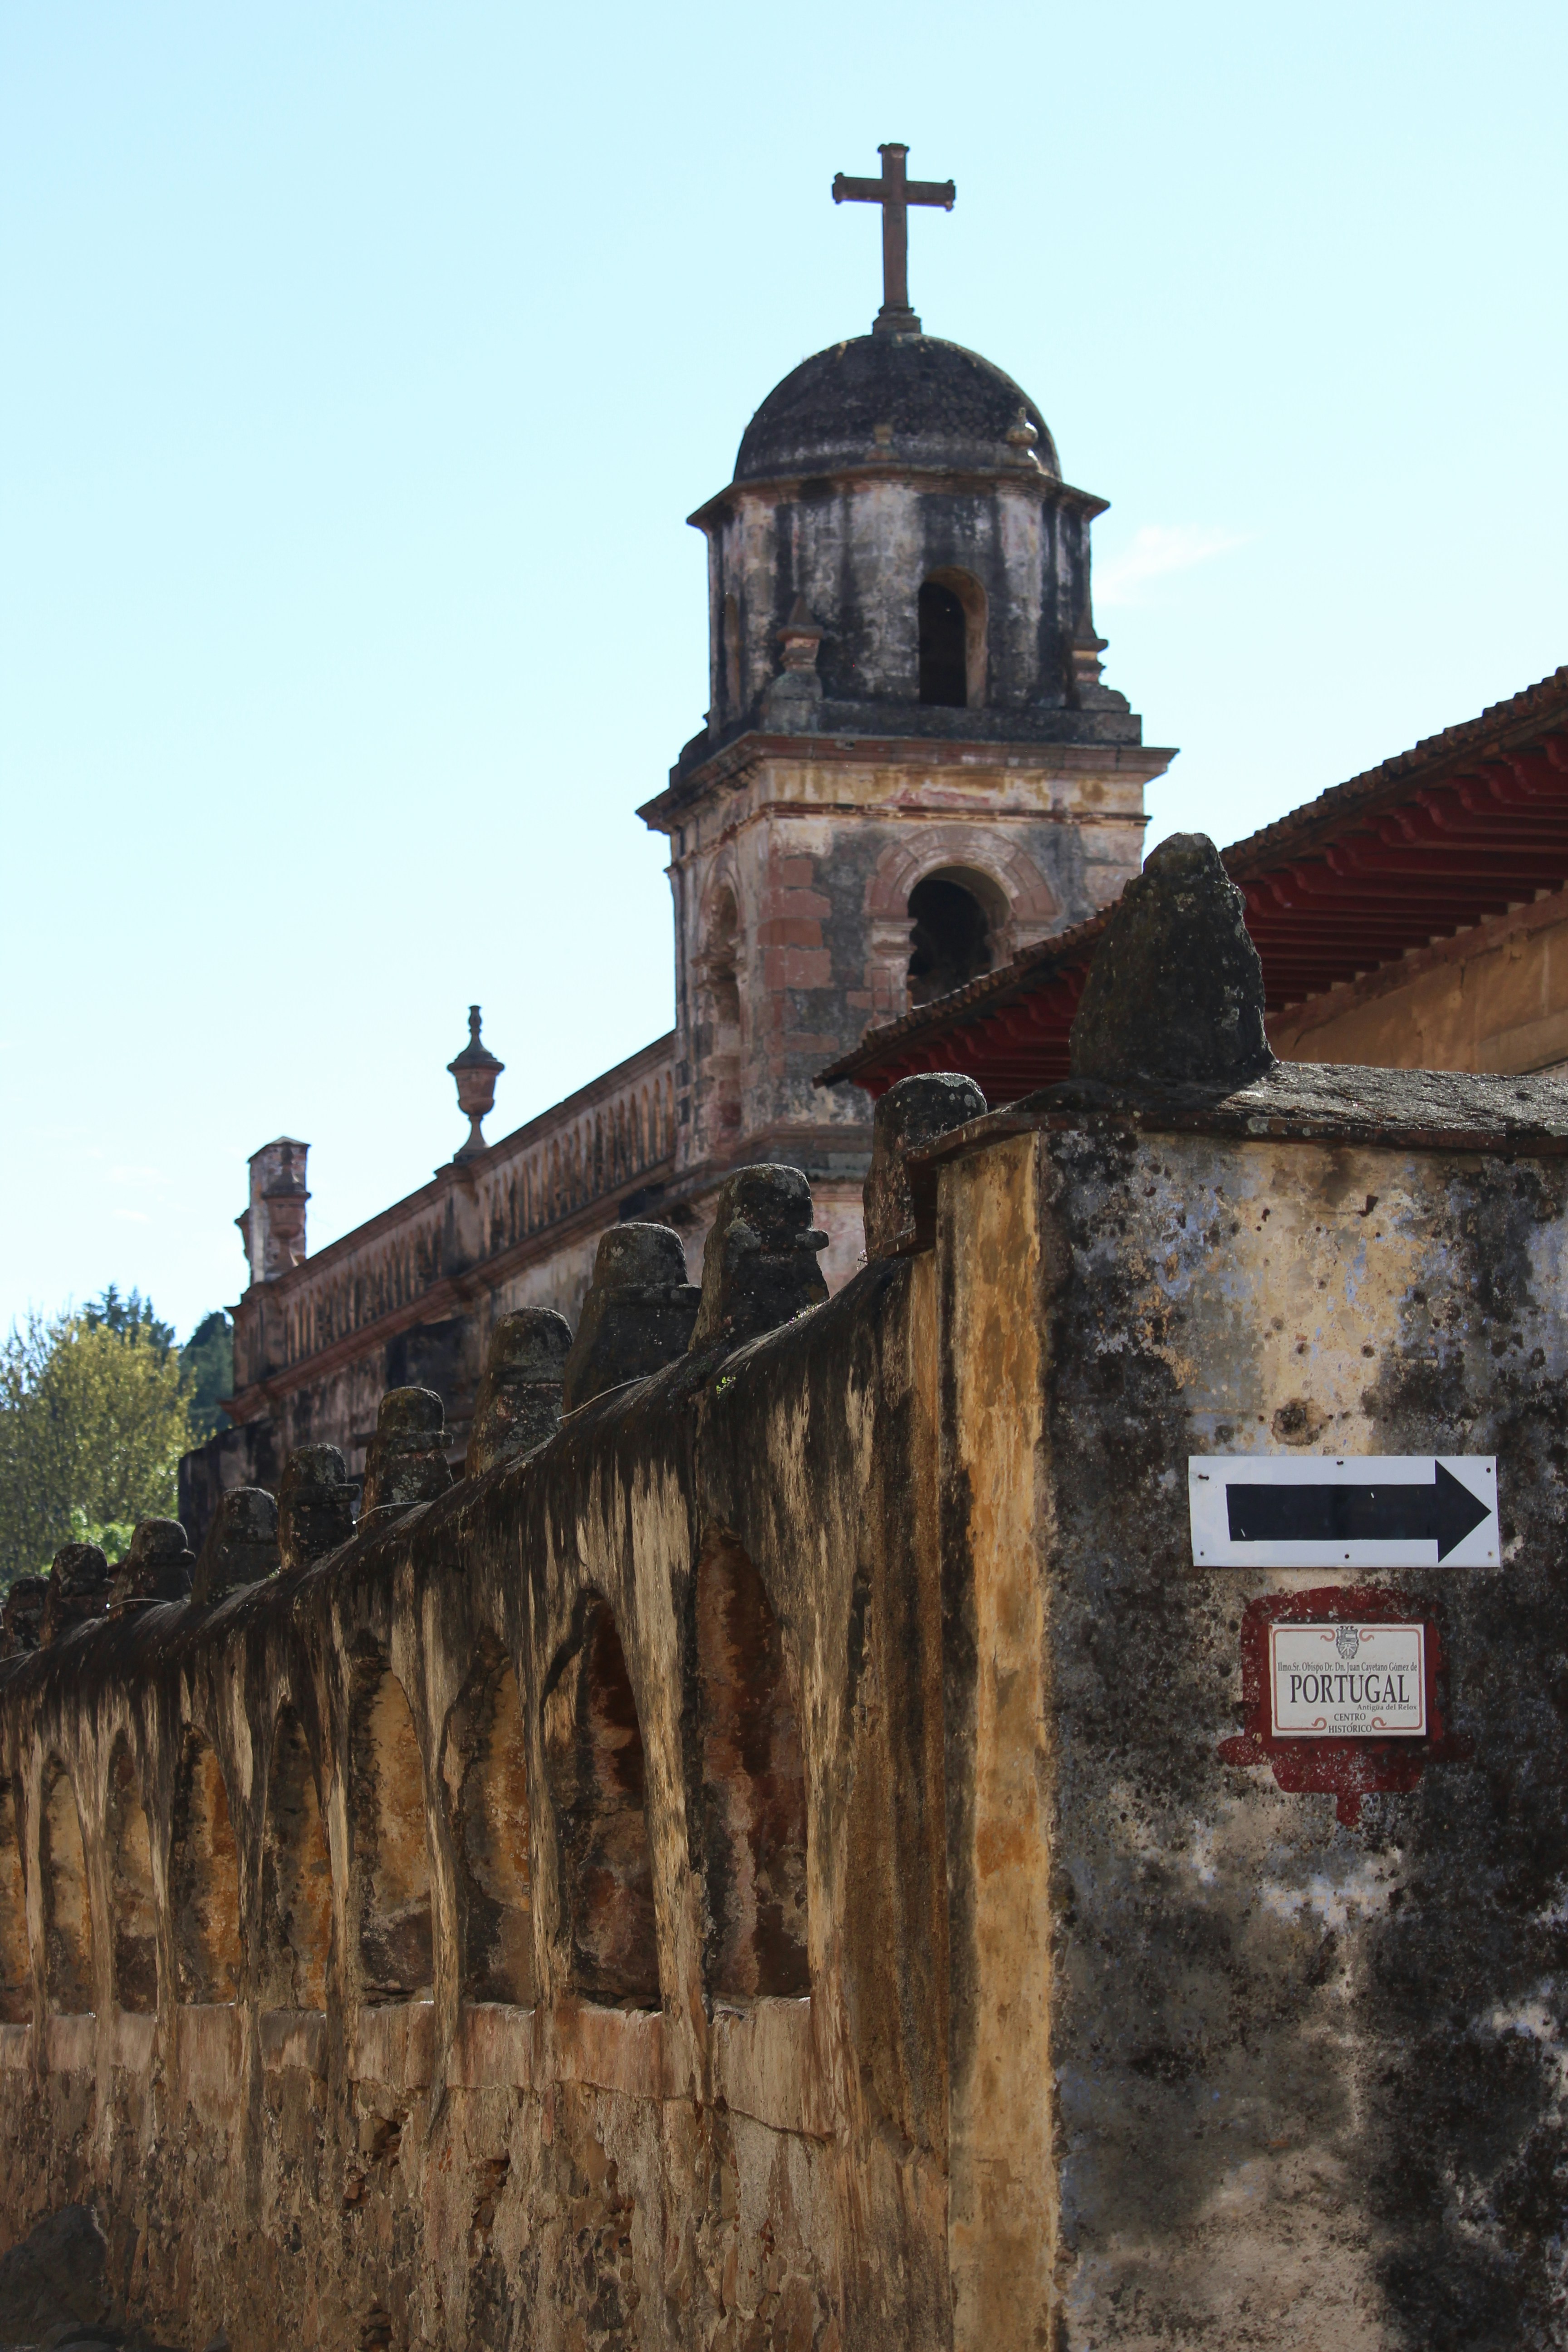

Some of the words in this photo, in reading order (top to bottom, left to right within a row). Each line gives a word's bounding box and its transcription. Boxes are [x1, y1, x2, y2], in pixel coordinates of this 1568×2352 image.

[1302, 1662, 1323, 1674] Obispo
[1325, 1662, 1333, 1671] Dr.
[1335, 1662, 1345, 1671] Dn.
[1347, 1662, 1360, 1673] Juan
[1361, 1662, 1387, 1674] Cayetano
[1389, 1662, 1409, 1671] Gómez
[1410, 1662, 1417, 1671] de
[1290, 1675, 1410, 1703] PORTUGAL
[1328, 1722, 1372, 1733] HISTÓRICO
